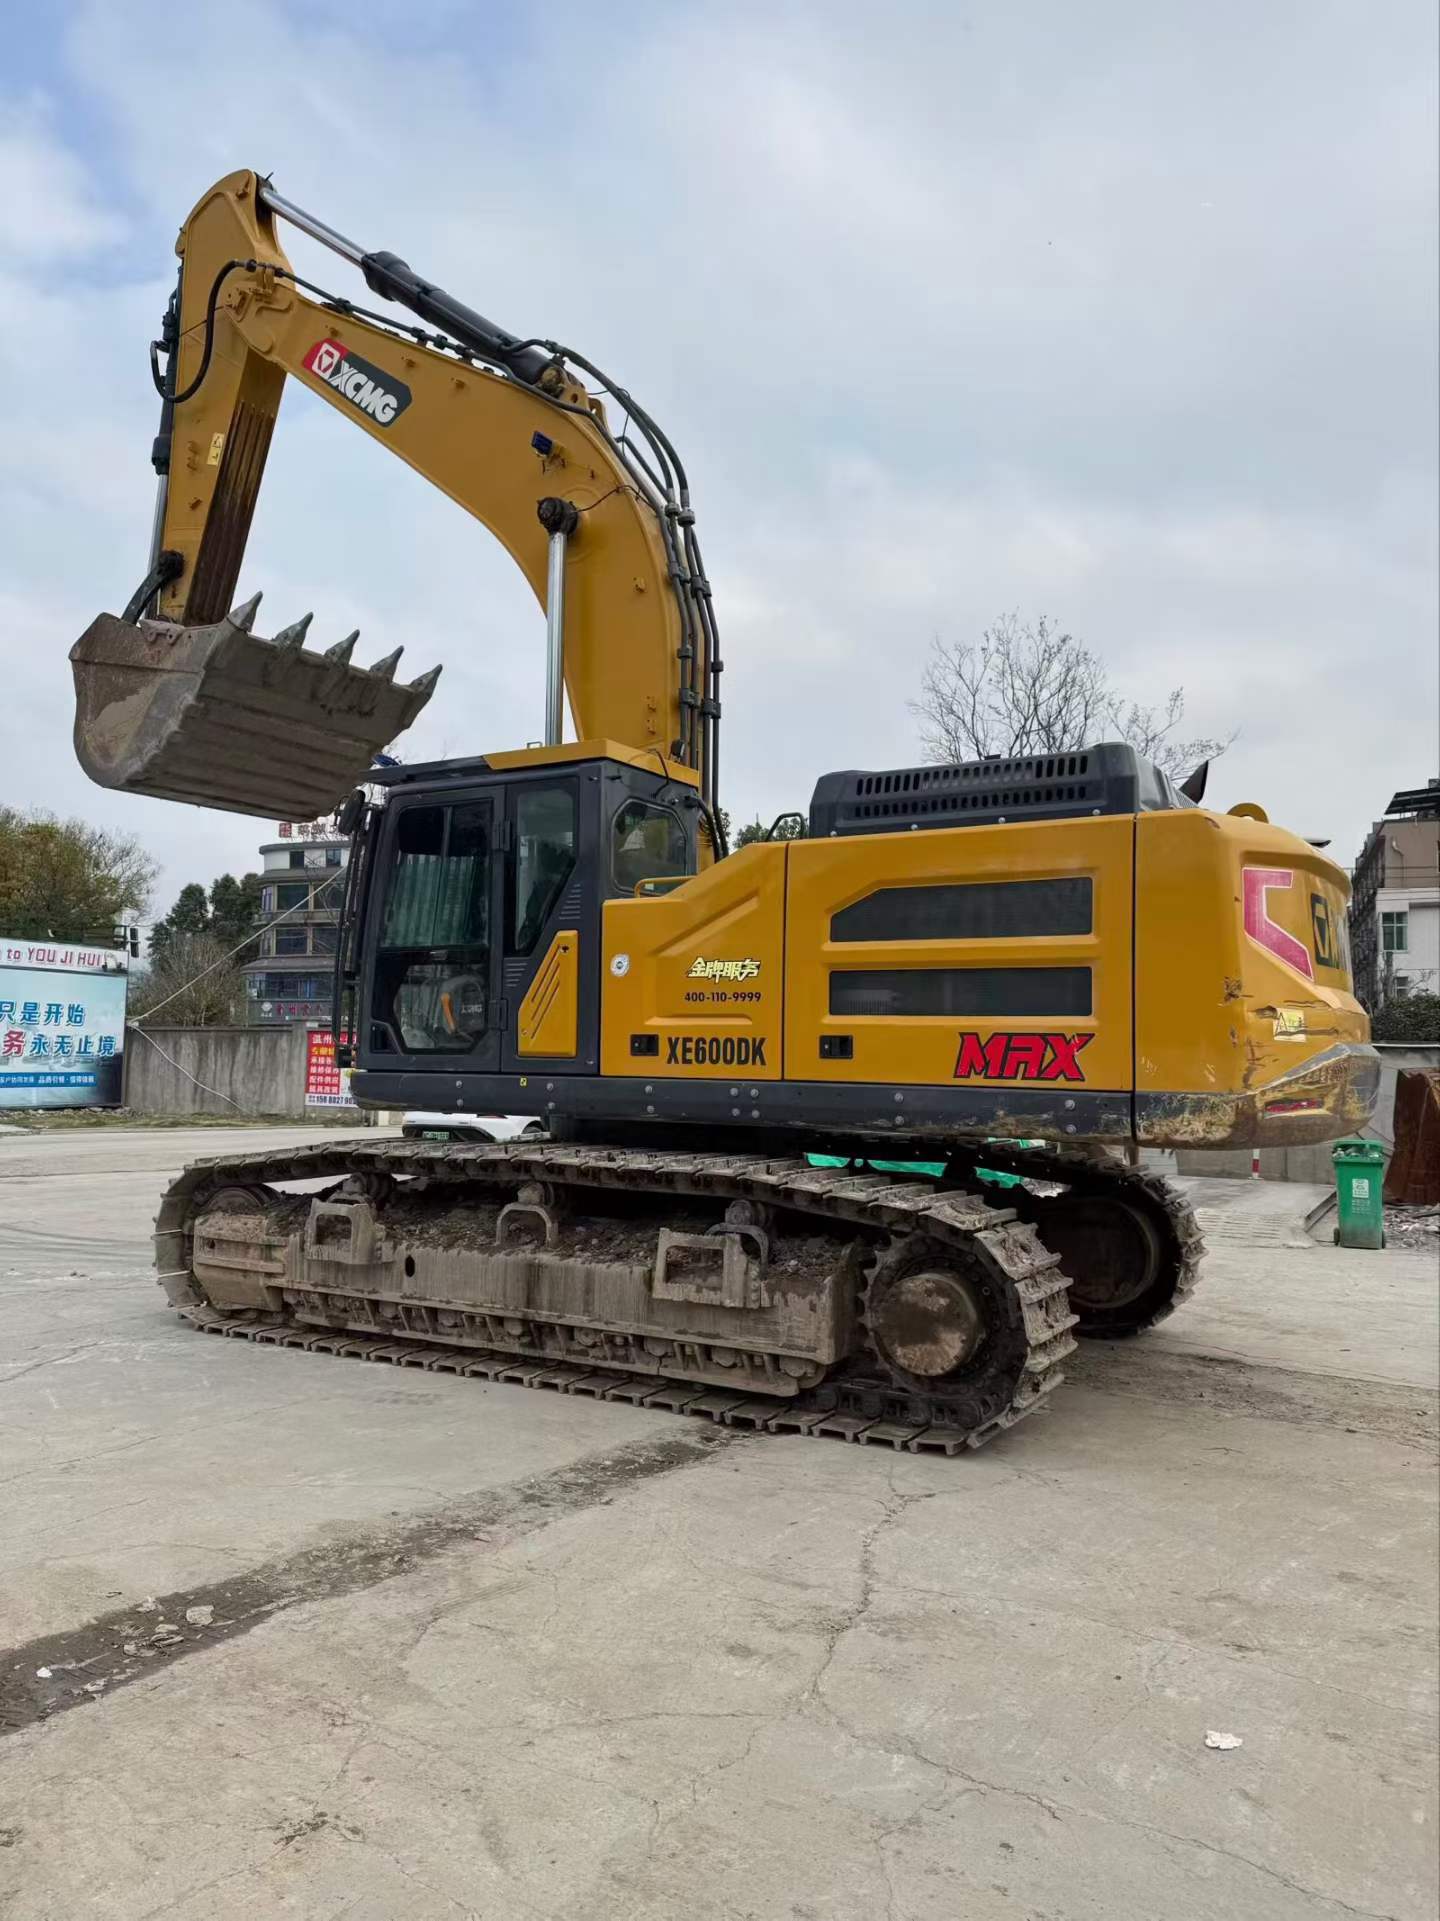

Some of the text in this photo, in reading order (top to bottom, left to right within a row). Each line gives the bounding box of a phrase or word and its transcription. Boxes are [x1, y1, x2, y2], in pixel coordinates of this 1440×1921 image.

[328, 360, 397, 423] XCMG
[7, 947, 101, 966] to YOU JI HUI
[688, 957, 761, 983] 金牌服务
[684, 992, 762, 1003] 400-110-9999
[0, 1001, 84, 1025] 只是开始
[667, 1036, 767, 1066] XE600DK
[954, 1032, 1095, 1082] MAX
